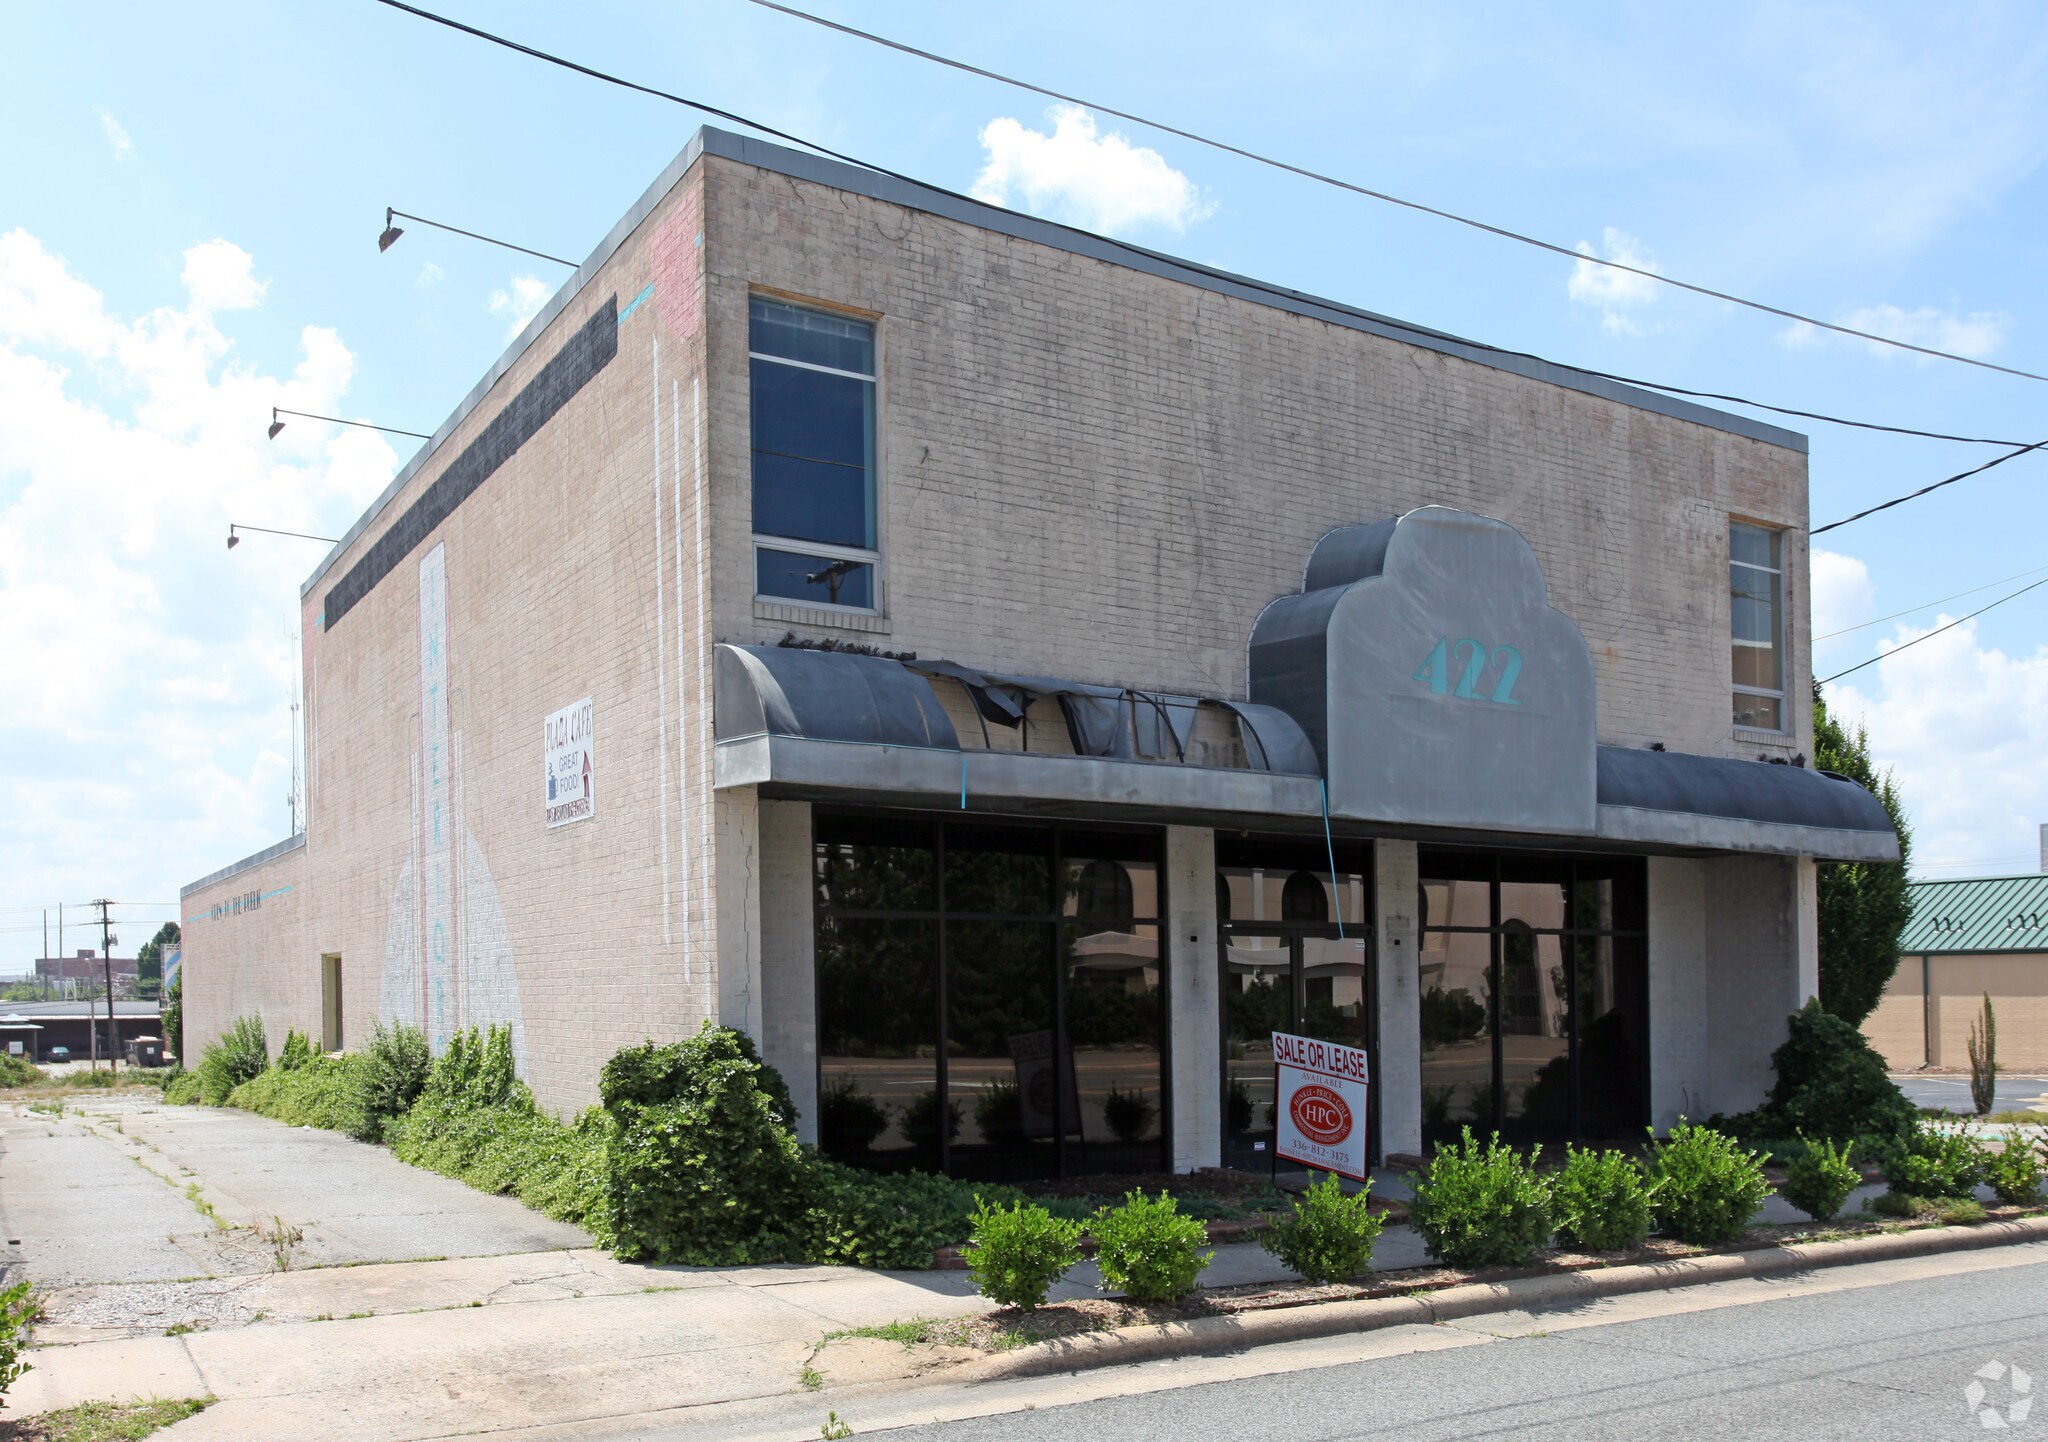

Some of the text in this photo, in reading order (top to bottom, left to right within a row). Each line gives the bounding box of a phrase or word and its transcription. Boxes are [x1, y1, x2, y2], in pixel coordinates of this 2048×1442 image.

[1412, 635, 1524, 706] 422
[546, 704, 592, 752] PLAZA CAFE
[558, 751, 579, 772] GREAT
[560, 773, 579, 793] FOOD!
[1275, 1035, 1366, 1079] SALE OR LEASE
[1301, 1072, 1344, 1089] AVAILABLE
[1293, 1088, 1349, 1118] HINKLE PRICE COLE
[1305, 1104, 1337, 1127] HPC
[1291, 1139, 1350, 1162] 336-812-3175
